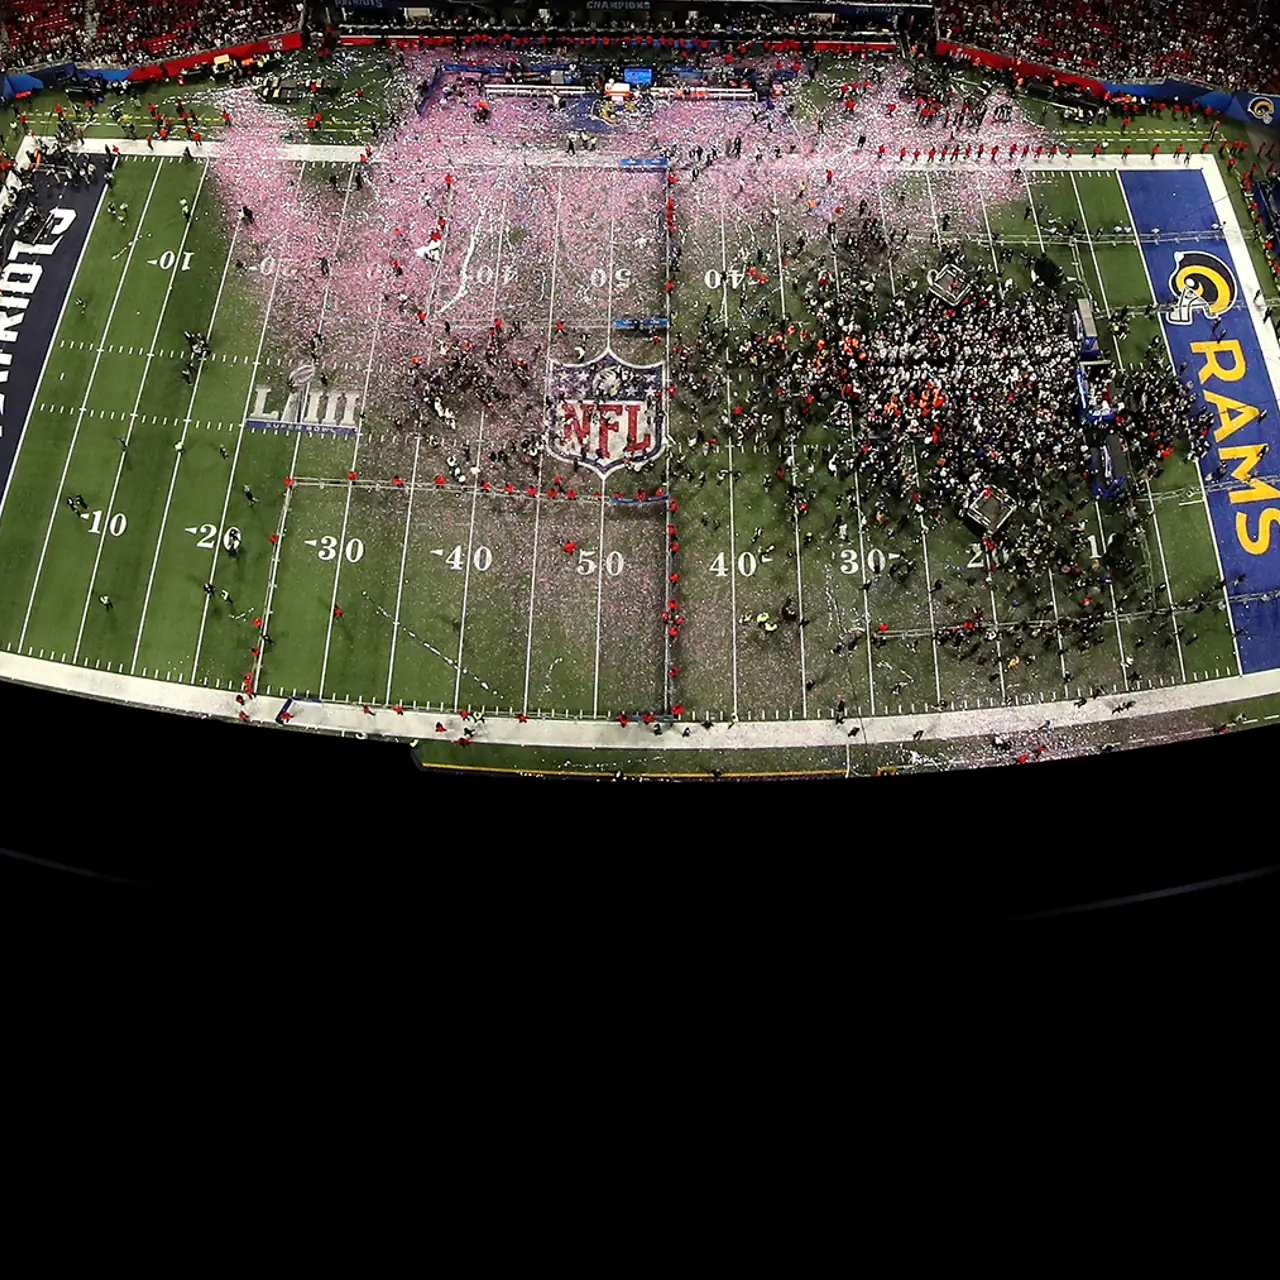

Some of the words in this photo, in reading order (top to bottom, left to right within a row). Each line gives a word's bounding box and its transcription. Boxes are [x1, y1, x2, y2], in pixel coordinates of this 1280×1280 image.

[250, 385, 361, 426] LIII
[265, 422, 302, 431] SUPER
[306, 425, 337, 434] BOWL
[560, 403, 652, 459] NFL
[88, 510, 128, 537] 10
[318, 536, 365, 564] 30
[445, 545, 493, 572] 40
[576, 549, 624, 576] 50
[709, 552, 758, 577] 40
